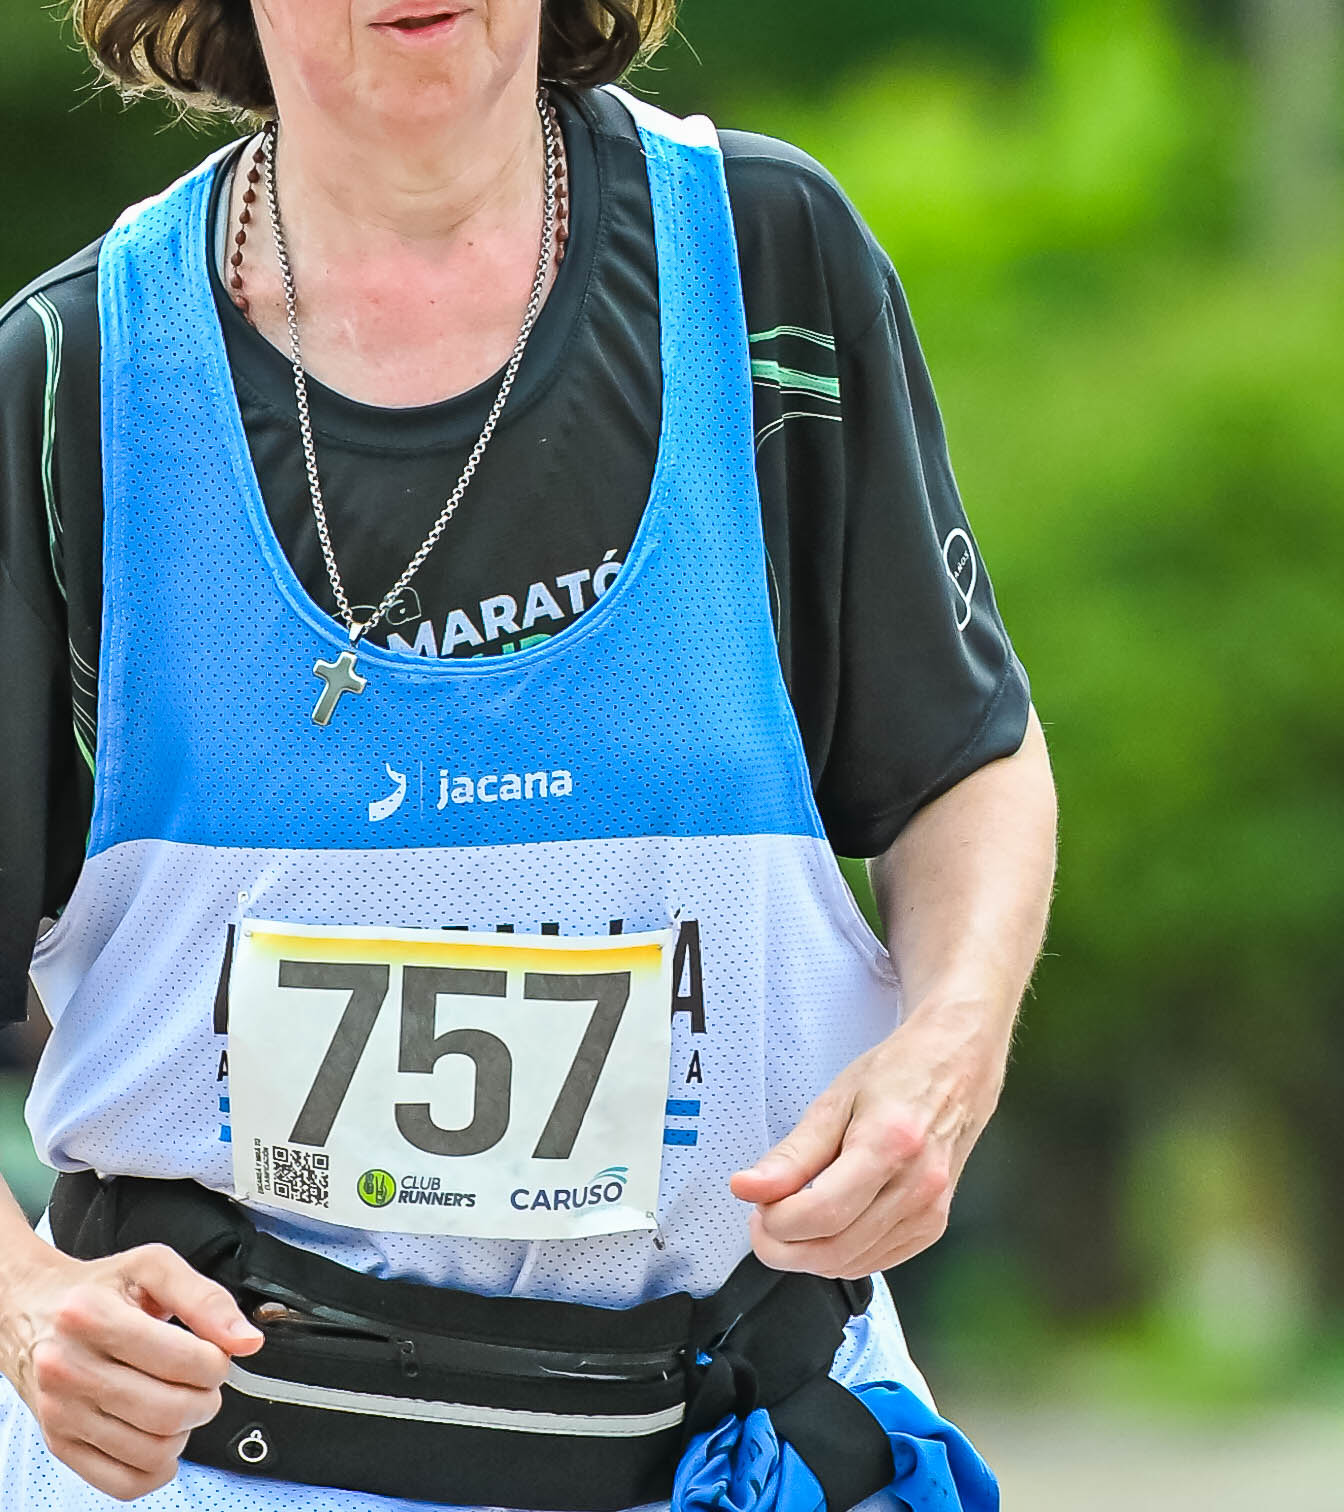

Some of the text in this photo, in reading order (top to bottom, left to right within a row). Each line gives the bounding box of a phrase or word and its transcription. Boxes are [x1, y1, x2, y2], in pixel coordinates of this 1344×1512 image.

[436, 767, 574, 810] jacana
[278, 959, 632, 1161] 757
[400, 1175, 441, 1191] CLUB
[510, 1181, 623, 1211] CARUSO
[397, 1190, 477, 1208] RUNNER'S
